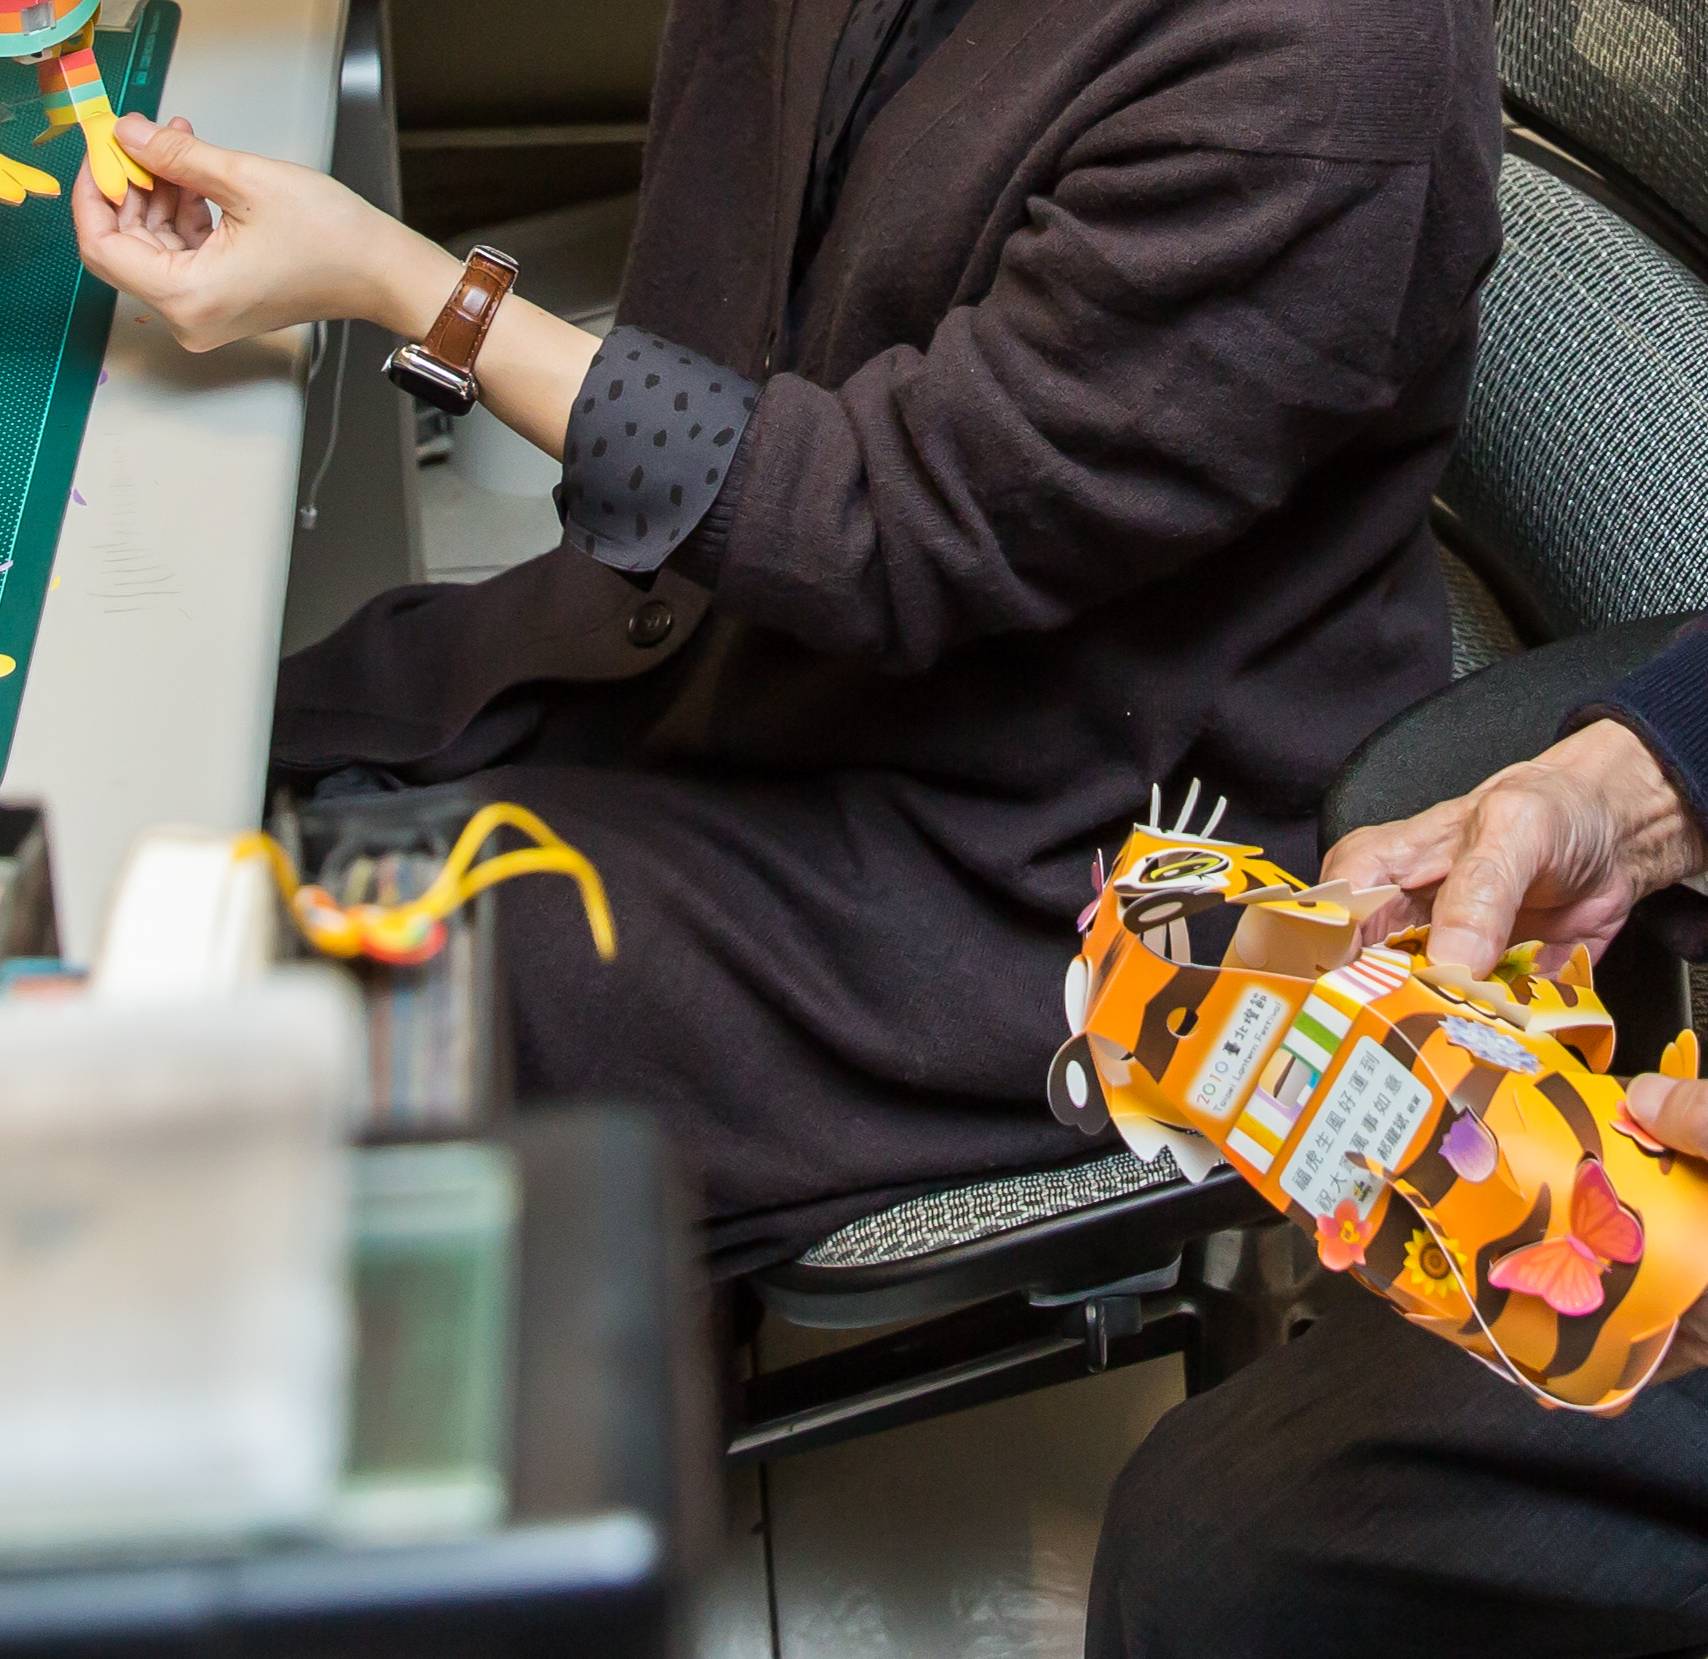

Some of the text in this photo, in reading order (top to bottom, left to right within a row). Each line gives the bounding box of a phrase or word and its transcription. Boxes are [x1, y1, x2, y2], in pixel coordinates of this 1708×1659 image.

[1196, 1059, 1229, 1105] 2010
[1231, 1043, 1259, 1081] Lantern
[1292, 1050, 1379, 1191] 福虎生風好運到
